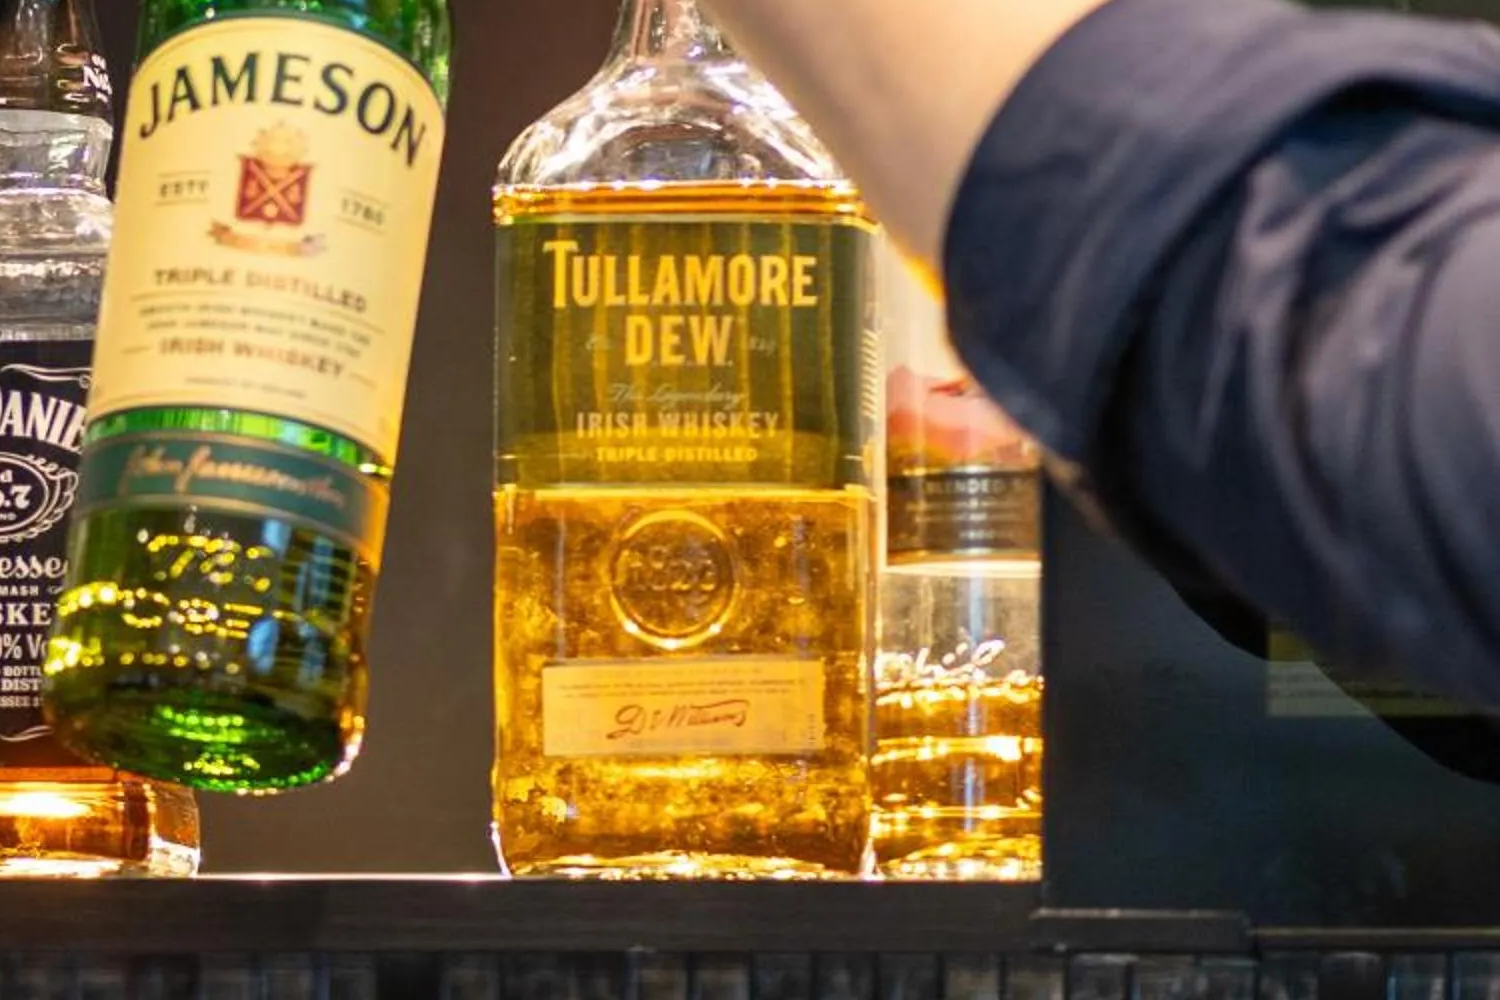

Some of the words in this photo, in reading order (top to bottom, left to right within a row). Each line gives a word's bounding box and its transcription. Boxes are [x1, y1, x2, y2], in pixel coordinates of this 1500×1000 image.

[139, 51, 427, 170] JAMESON
[154, 268, 236, 287] TRIPLE
[245, 271, 368, 313] DISTILLED
[542, 239, 818, 309] TULLAMORE
[159, 336, 225, 357] IRISH
[233, 339, 346, 378] WHISKEY
[577, 412, 648, 439] IRISH
[657, 411, 780, 439] WHISKEY
[596, 446, 660, 463] TRIPLE
[665, 446, 759, 463] DISTILLED
[4, 665, 41, 677] BOTT
